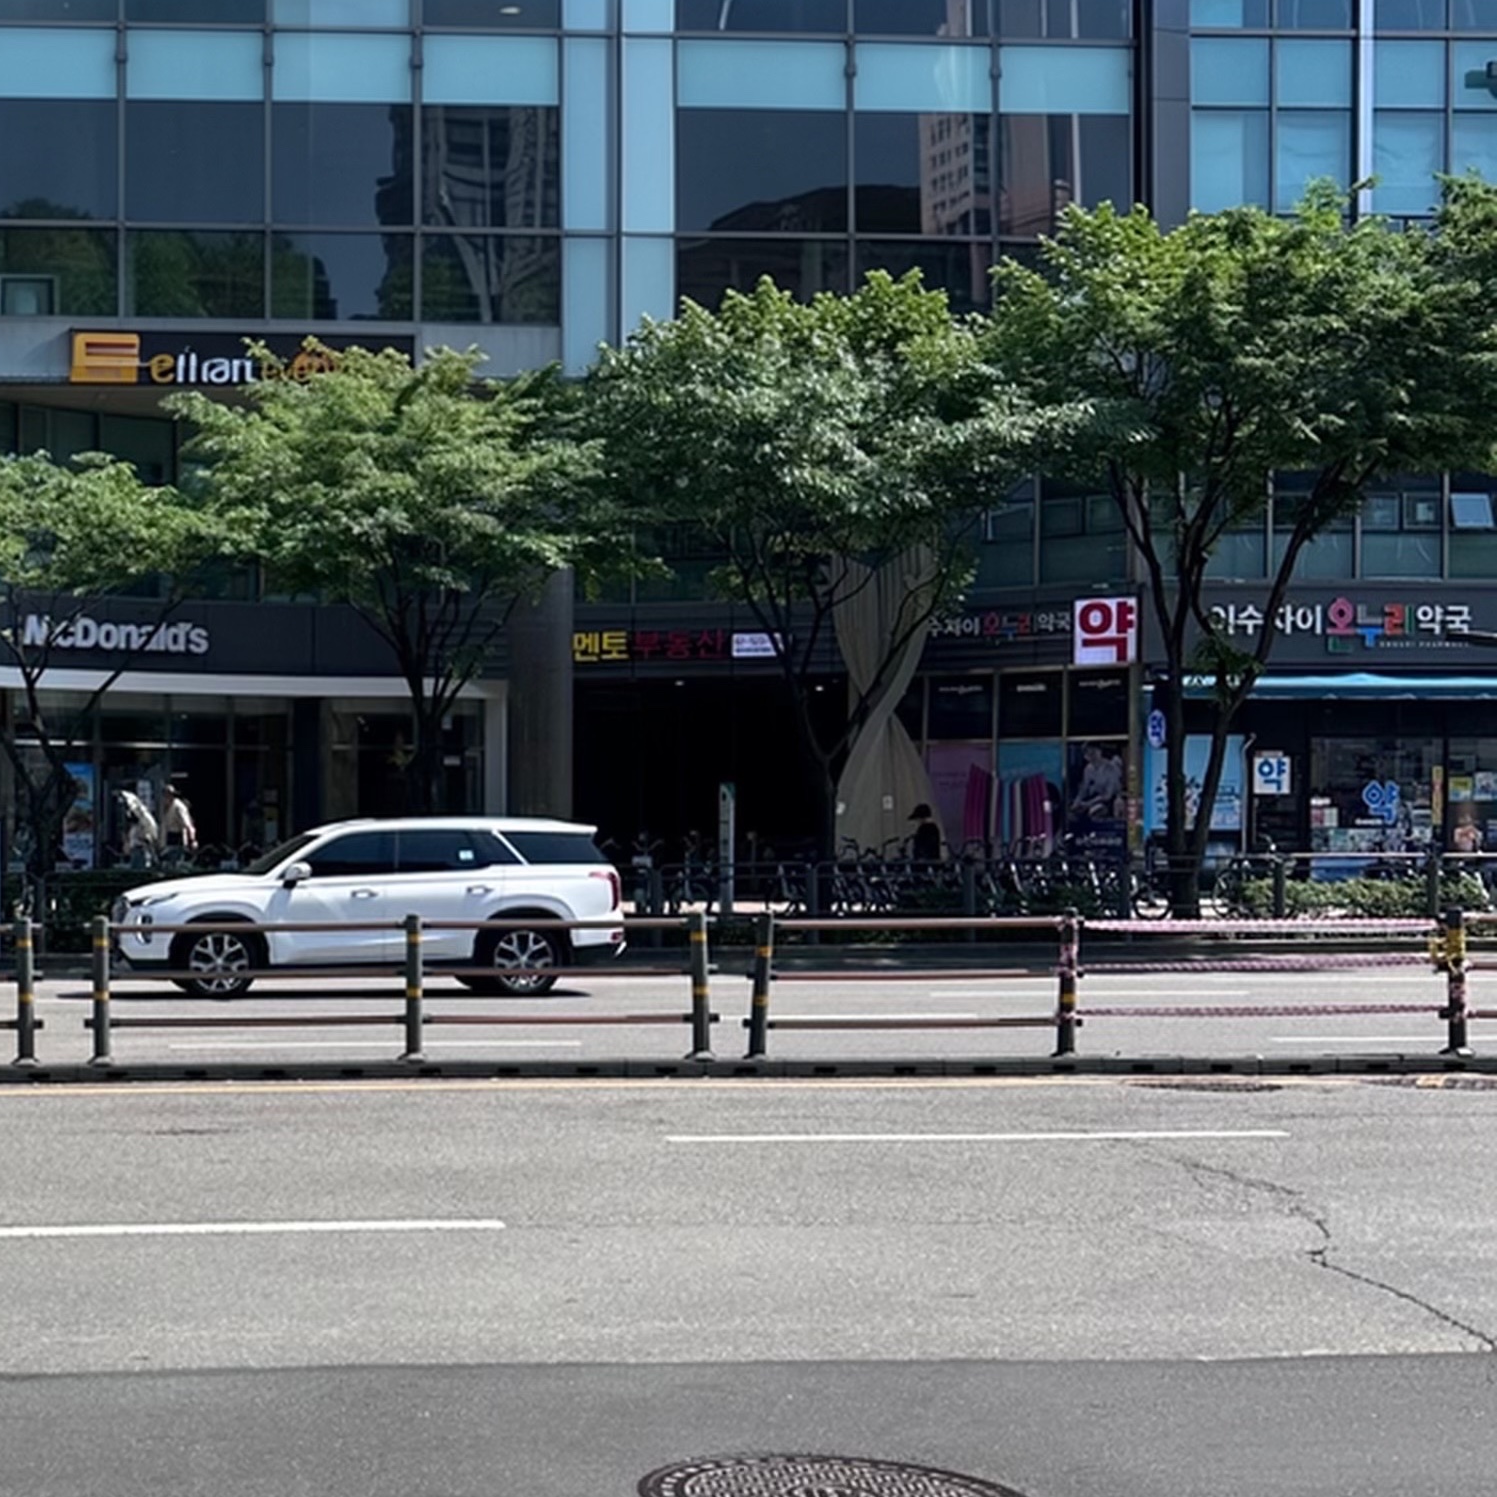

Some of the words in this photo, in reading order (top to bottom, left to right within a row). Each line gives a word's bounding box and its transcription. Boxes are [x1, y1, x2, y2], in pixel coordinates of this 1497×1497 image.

[572, 631, 629, 662] 멘토
[634, 628, 728, 660] 부동산
[1078, 601, 1136, 662] 약
[1257, 758, 1287, 792] 약
[1362, 780, 1400, 825] 약
